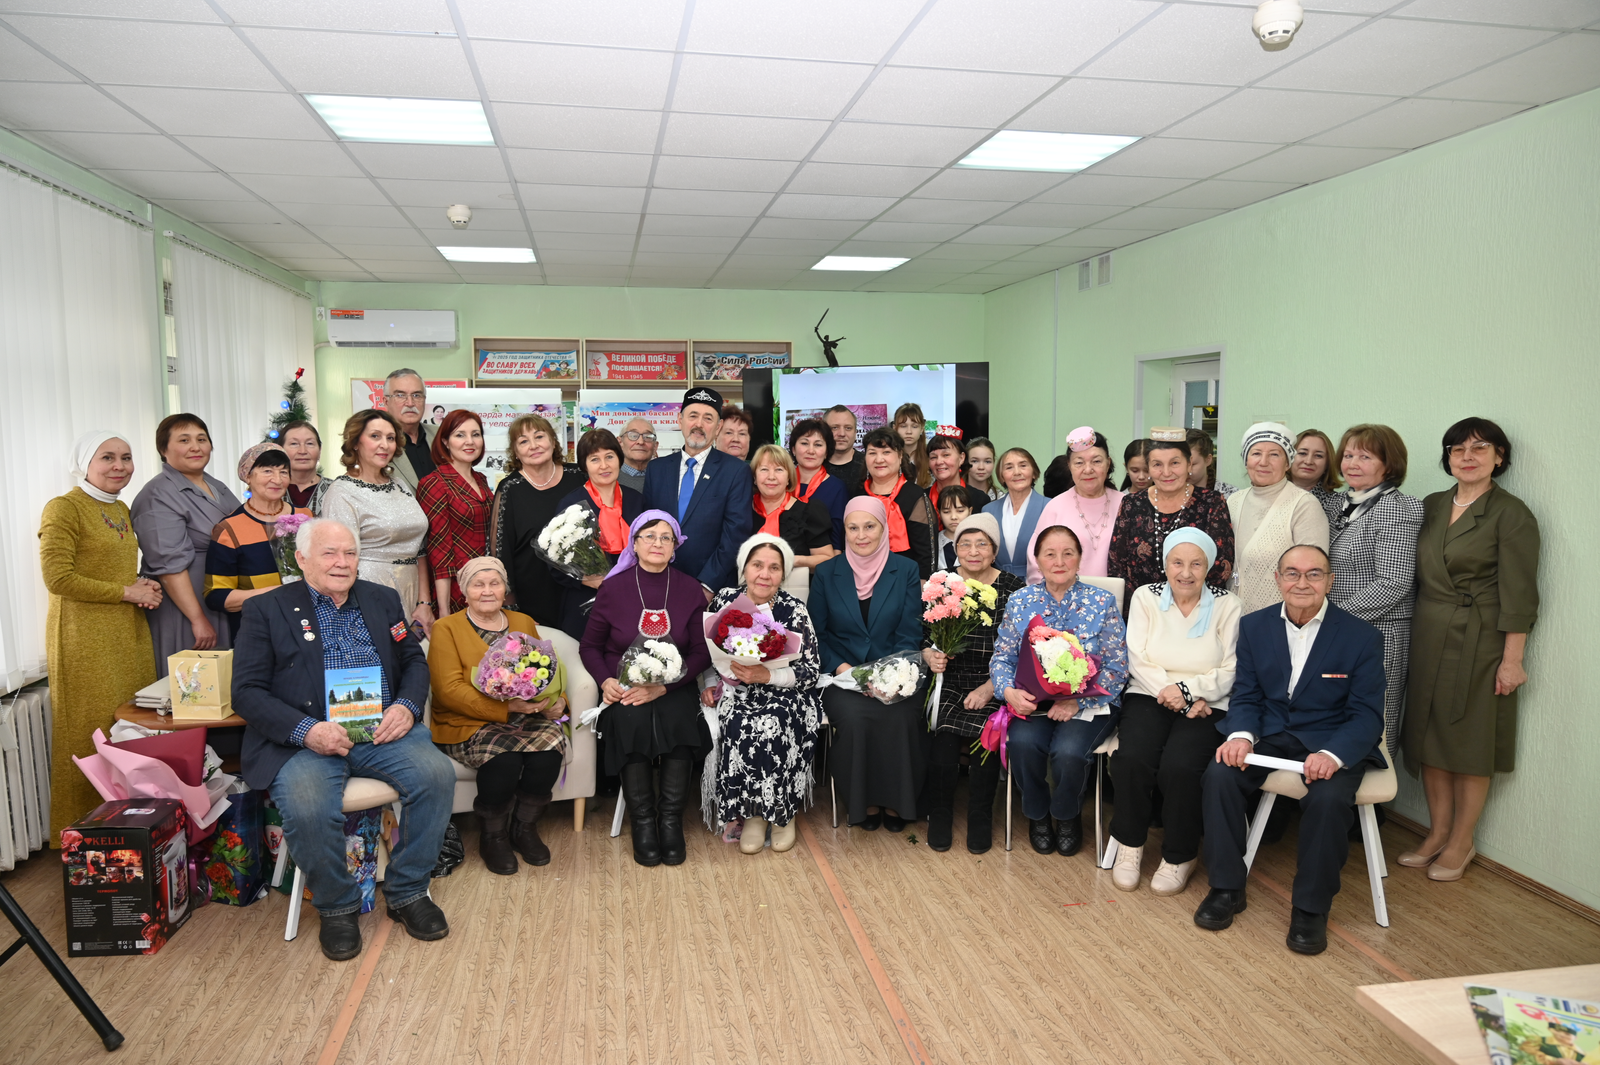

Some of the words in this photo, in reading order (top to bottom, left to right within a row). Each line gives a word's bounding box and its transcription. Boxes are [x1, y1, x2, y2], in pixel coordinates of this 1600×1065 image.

[611, 353, 646, 363] ВЕЛИКОЙ
[647, 354, 677, 364] ПОБЕДЕ
[721, 356, 746, 365] Сила
[749, 356, 786, 365] России
[486, 361, 495, 369] ВО
[496, 361, 518, 369] СЛАВУ
[519, 361, 536, 369] ВСЕХ
[611, 364, 663, 372] ПОСВЯЩАЕТСЯ!
[591, 409, 610, 417] Мин
[649, 409, 674, 417] басып
[92, 836, 125, 846] KELLI
